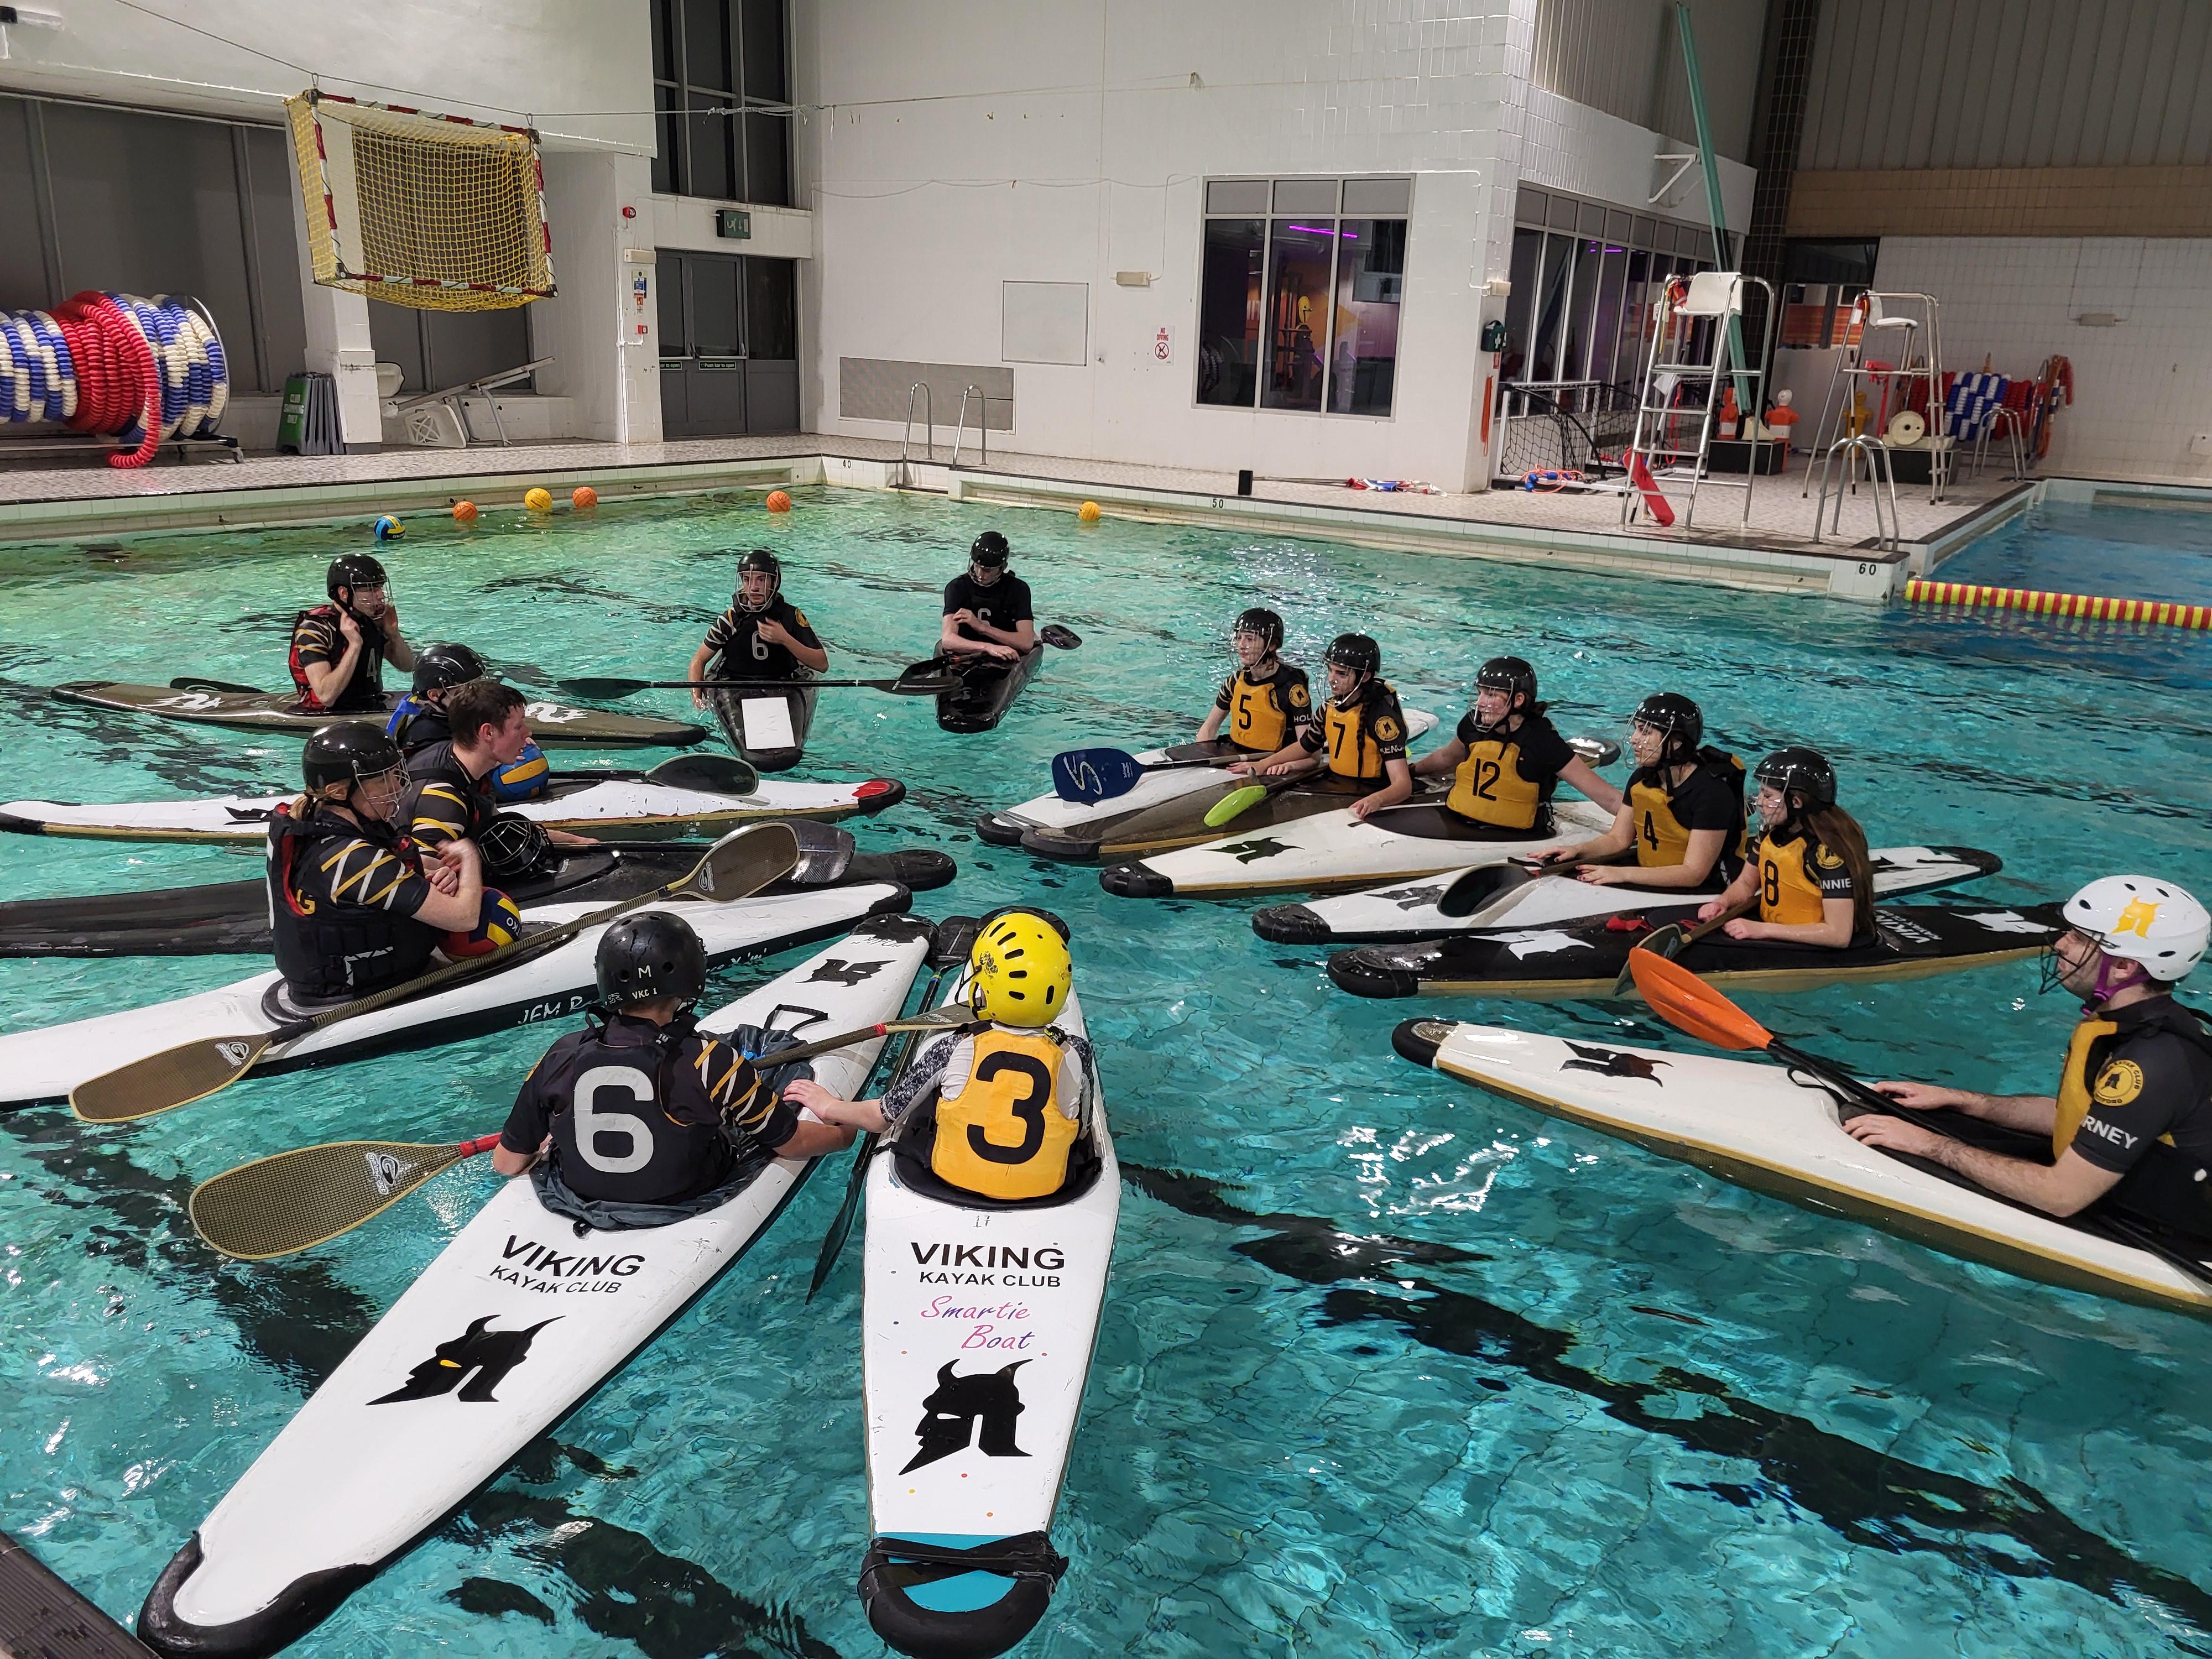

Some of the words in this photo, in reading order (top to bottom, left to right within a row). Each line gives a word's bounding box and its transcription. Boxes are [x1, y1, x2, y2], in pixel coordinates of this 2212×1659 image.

[842, 460, 851, 468] 40
[1212, 498, 1224, 508] 50
[1859, 563, 1876, 575] 60
[752, 630, 769, 660] 6
[367, 648, 377, 683] 4
[1239, 694, 1251, 730] 5
[1333, 722, 1345, 759] 7
[1472, 758, 1500, 801] 12
[1644, 810, 1659, 851] 4
[1764, 859, 1779, 907] 8
[638, 965, 652, 979] M
[632, 989, 650, 999] VKC
[573, 1065, 654, 1173] 6
[967, 1050, 1051, 1165] 3
[972, 1215, 991, 1228] 17
[502, 1234, 645, 1277] VIKING
[910, 1241, 1065, 1270] VIKING
[489, 1265, 566, 1293] KAYAK
[566, 1281, 622, 1293] CLUB
[919, 1271, 995, 1286] KAYAK
[1002, 1275, 1061, 1287] CLUB
[920, 1295, 1031, 1320] Smartie
[961, 1324, 1036, 1350] Boat
